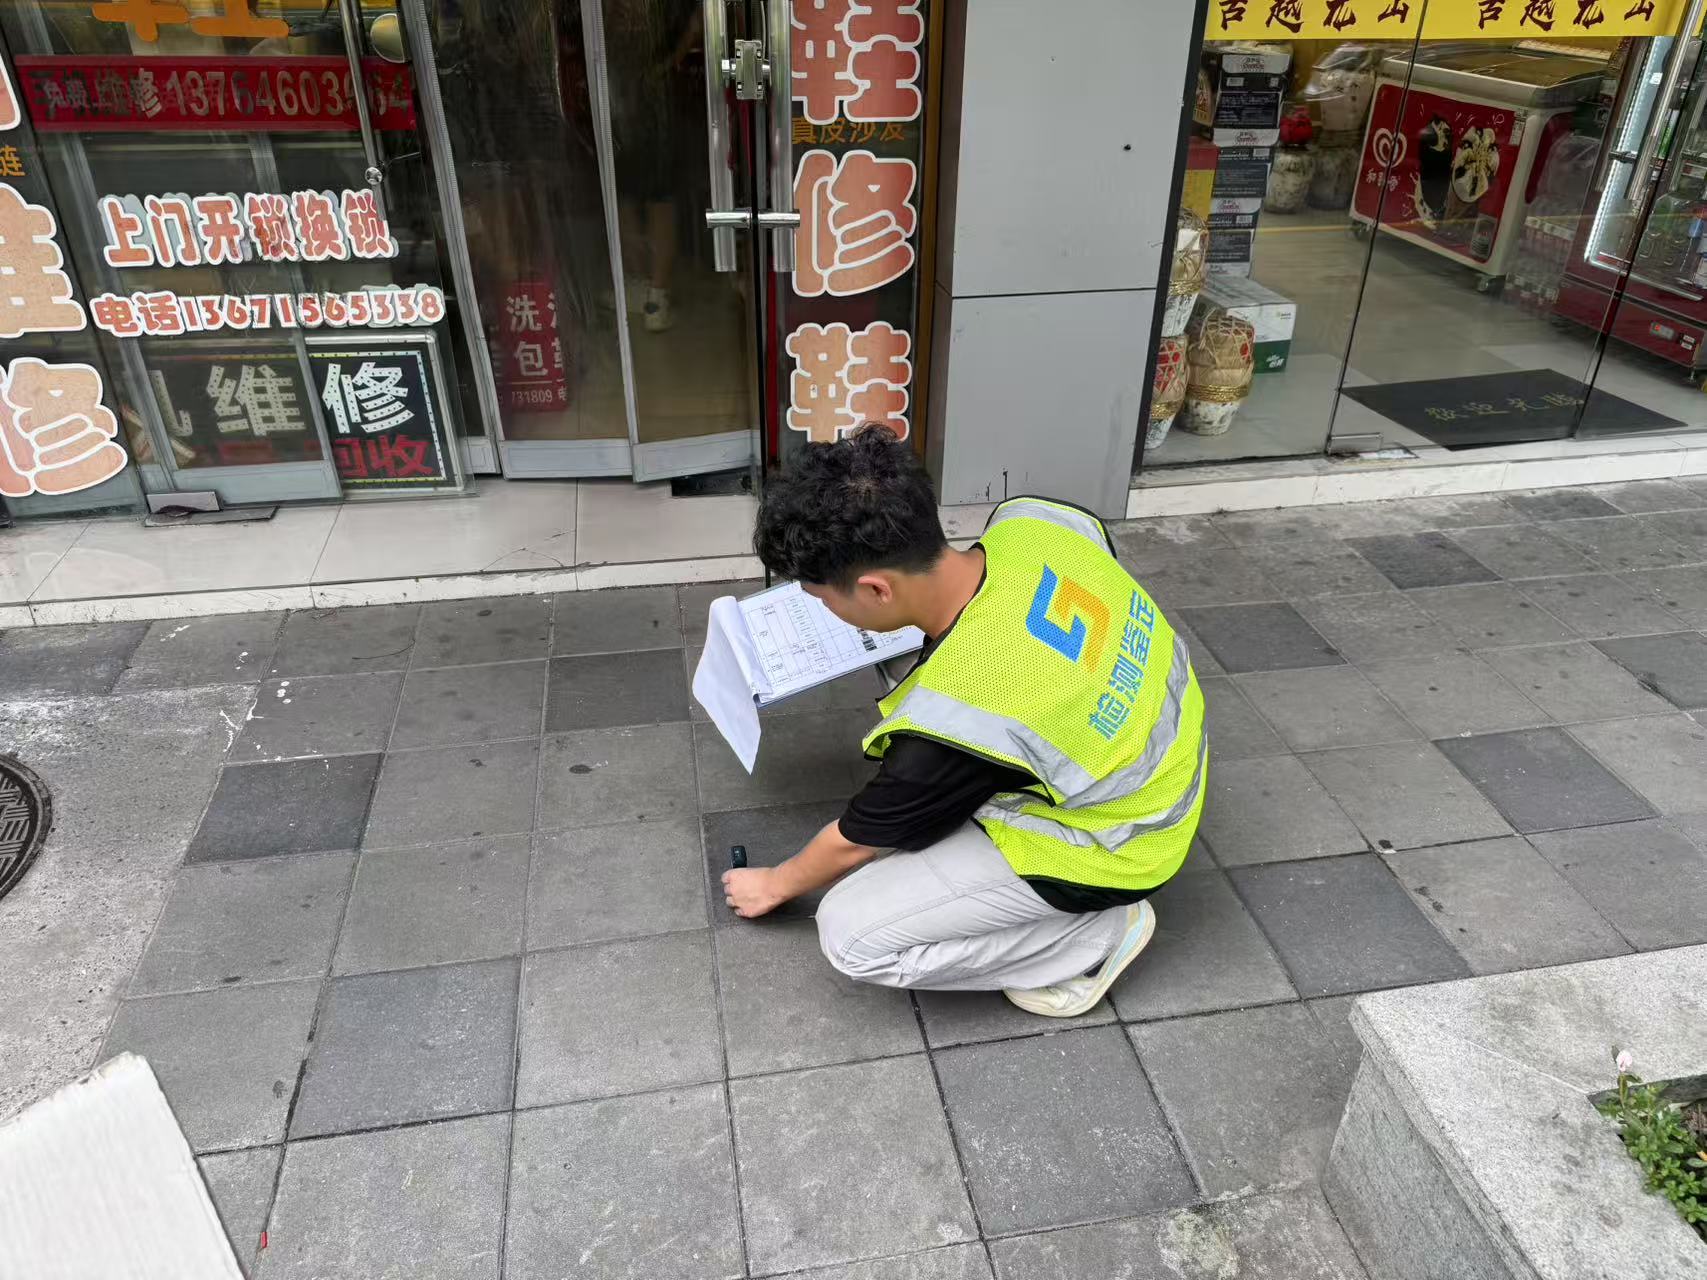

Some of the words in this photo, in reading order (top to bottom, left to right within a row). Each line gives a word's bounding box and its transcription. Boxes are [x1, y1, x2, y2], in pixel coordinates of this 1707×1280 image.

[100, 190, 396, 267] 上门开锁换锁
[90, 288, 446, 337] 电话13671565338
[1087, 588, 1156, 743] 检测鉴定
